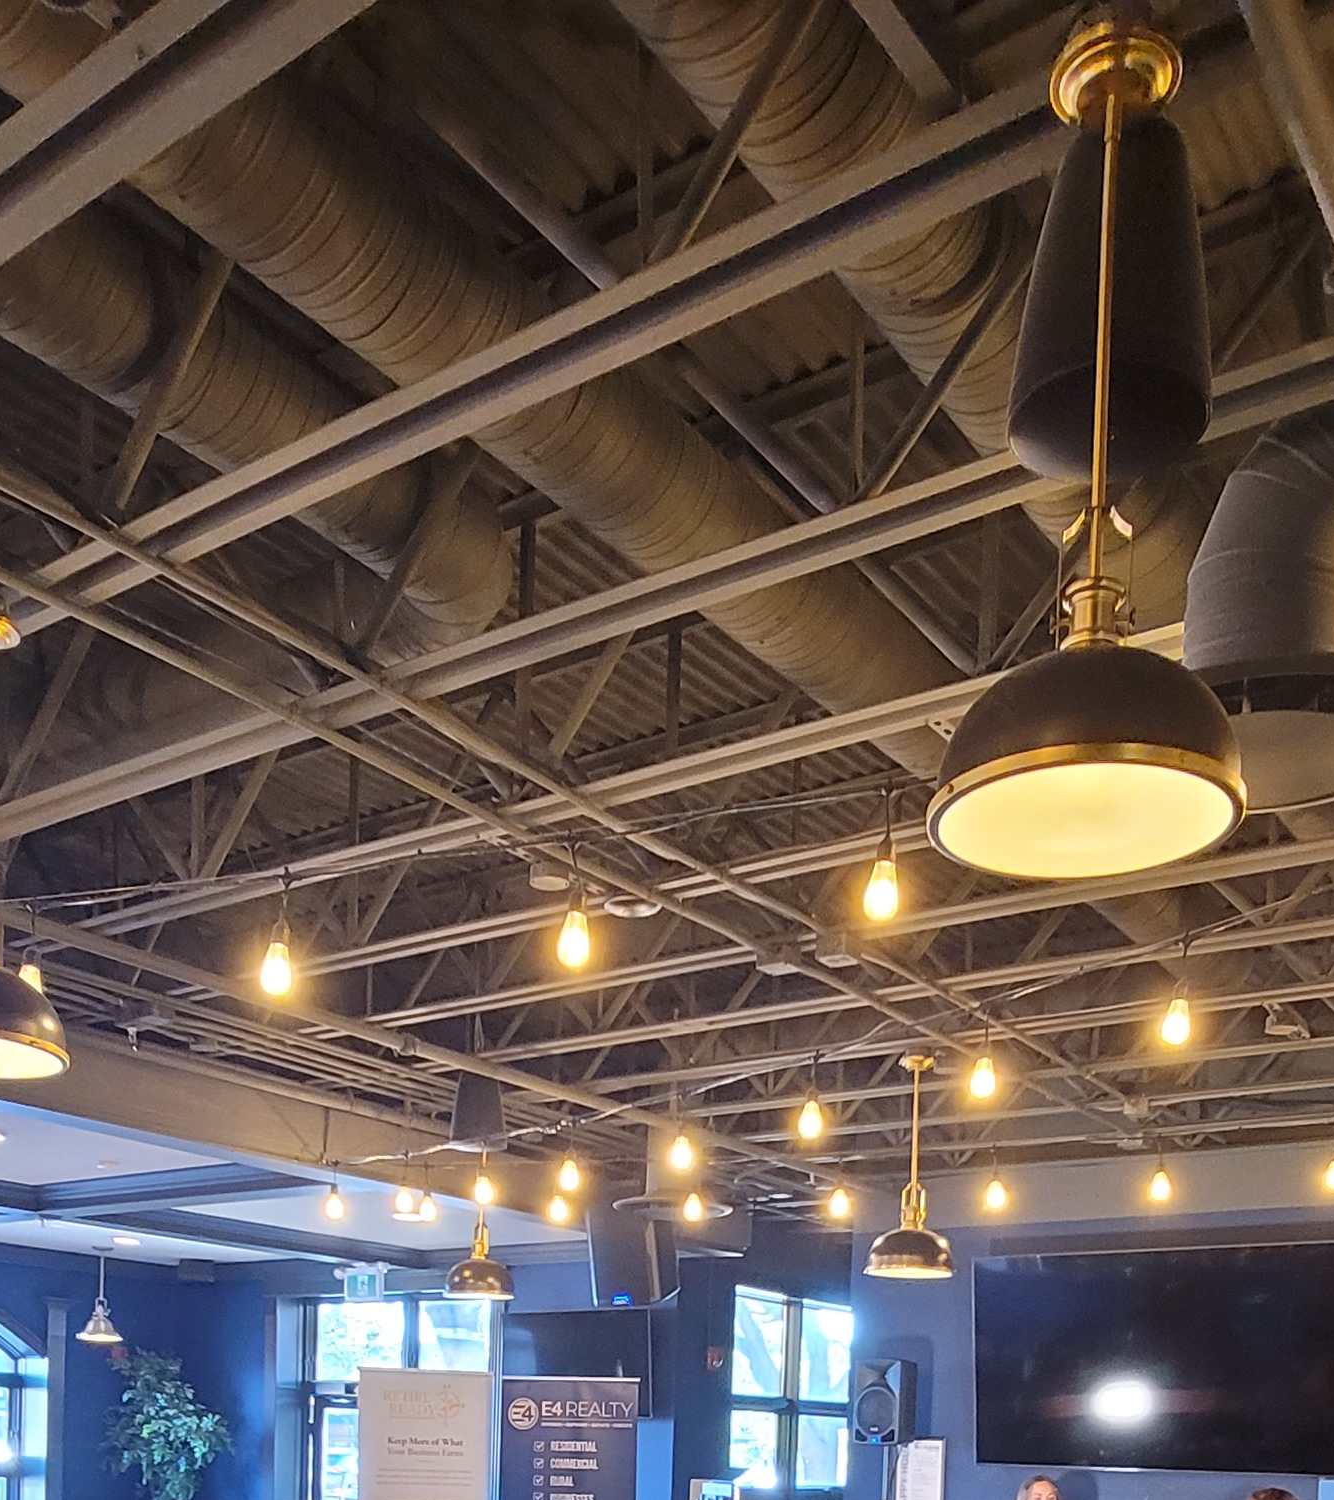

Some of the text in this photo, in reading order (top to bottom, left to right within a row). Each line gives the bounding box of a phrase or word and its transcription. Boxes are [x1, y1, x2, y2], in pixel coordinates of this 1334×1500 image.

[541, 1401, 563, 1416] E4
[566, 1401, 633, 1417] REALTY
[388, 1437, 463, 1447] Keep More of What
[408, 1448, 440, 1456] Business
